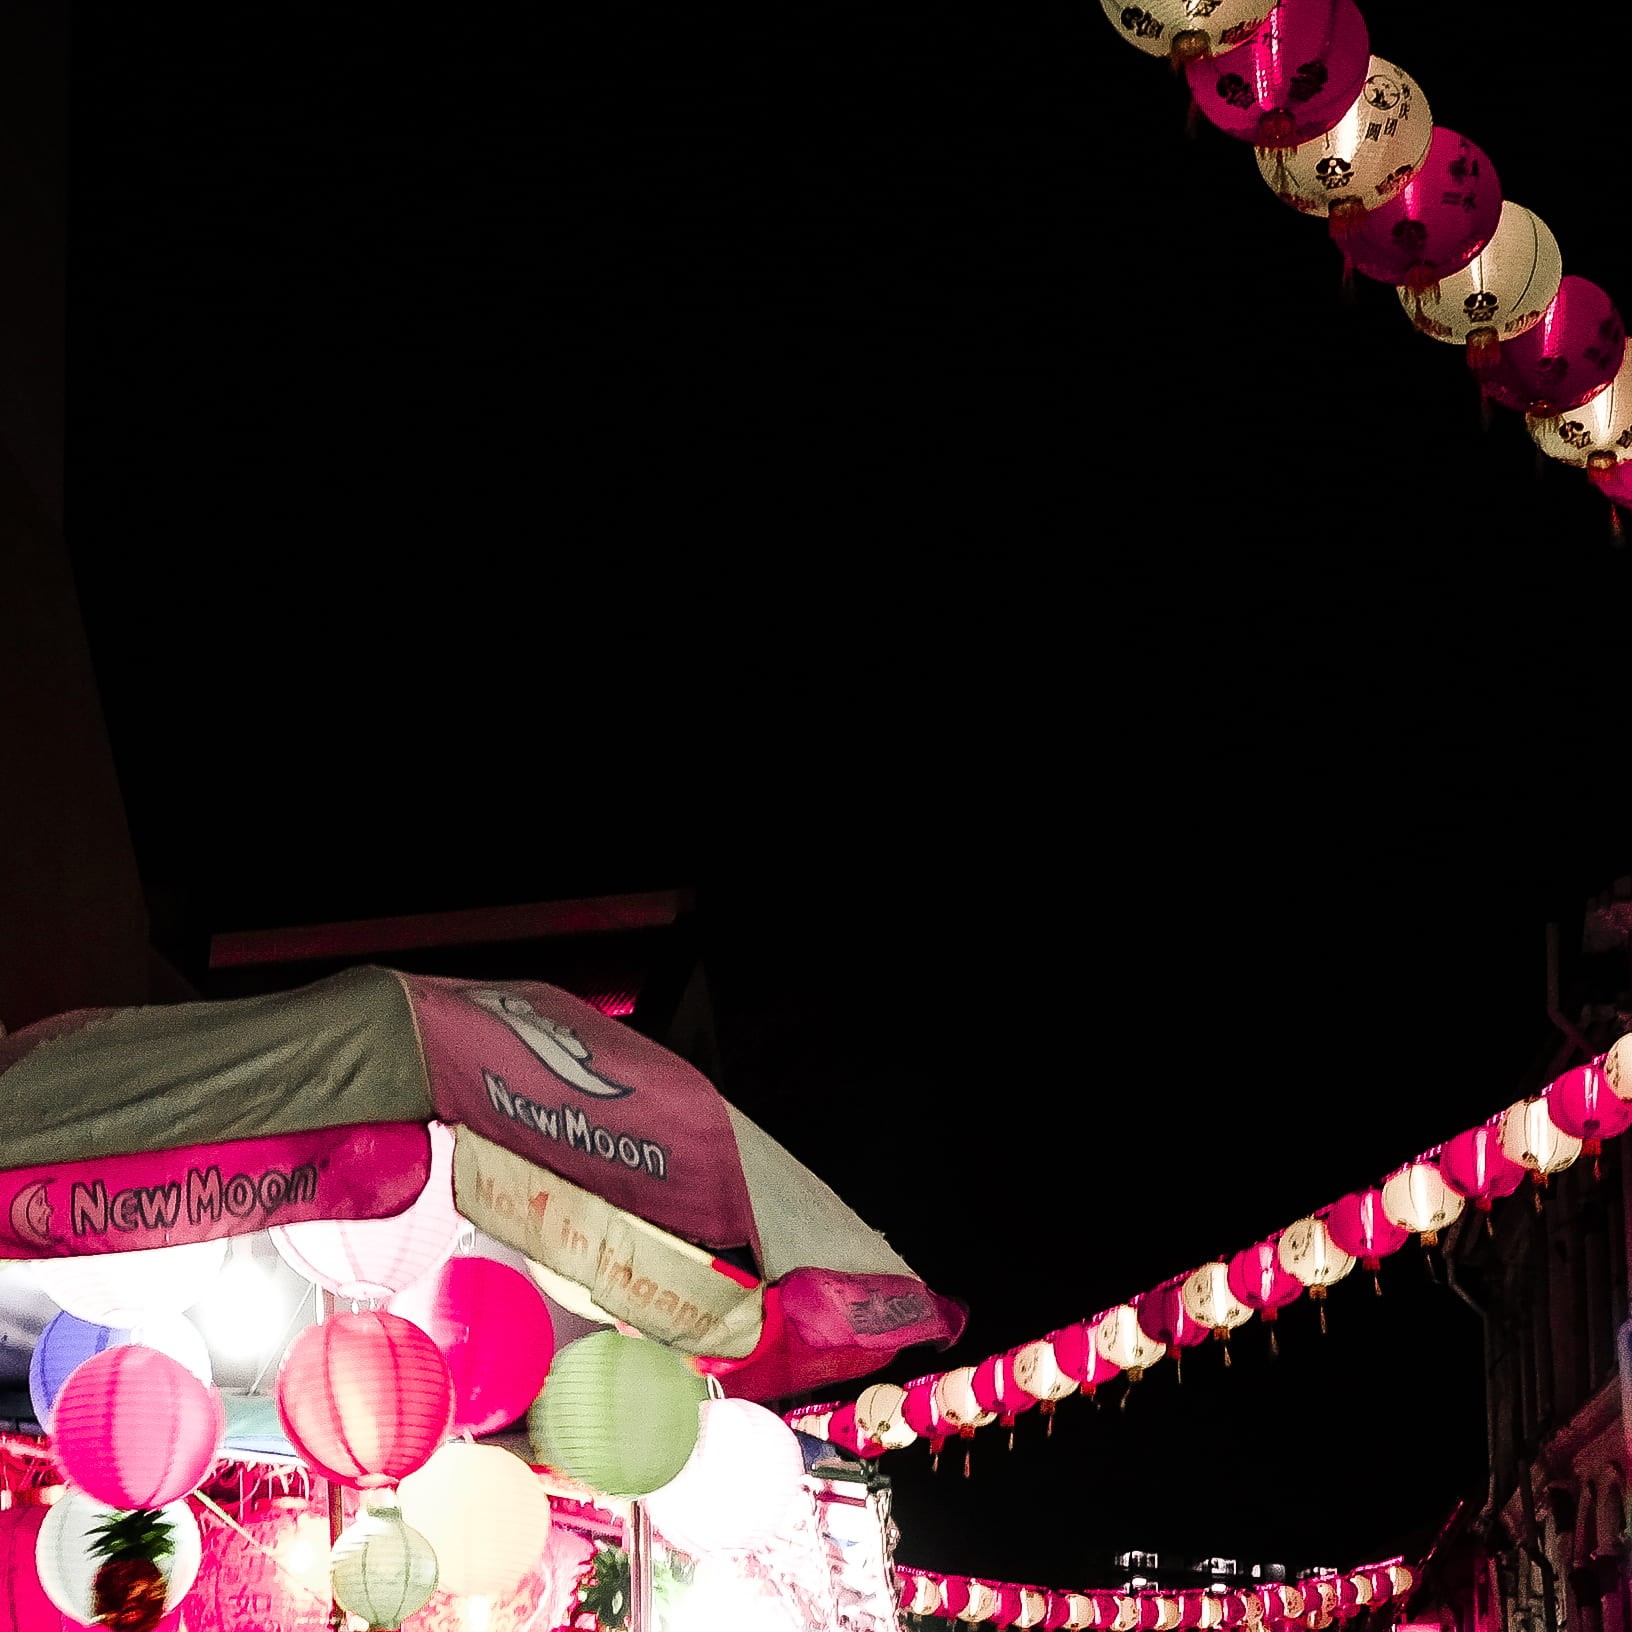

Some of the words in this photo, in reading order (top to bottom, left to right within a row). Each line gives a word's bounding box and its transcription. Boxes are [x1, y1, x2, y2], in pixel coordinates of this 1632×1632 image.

[561, 1102, 669, 1182] Moon
[71, 1178, 181, 1237] New
[186, 1164, 319, 1226] Moon
